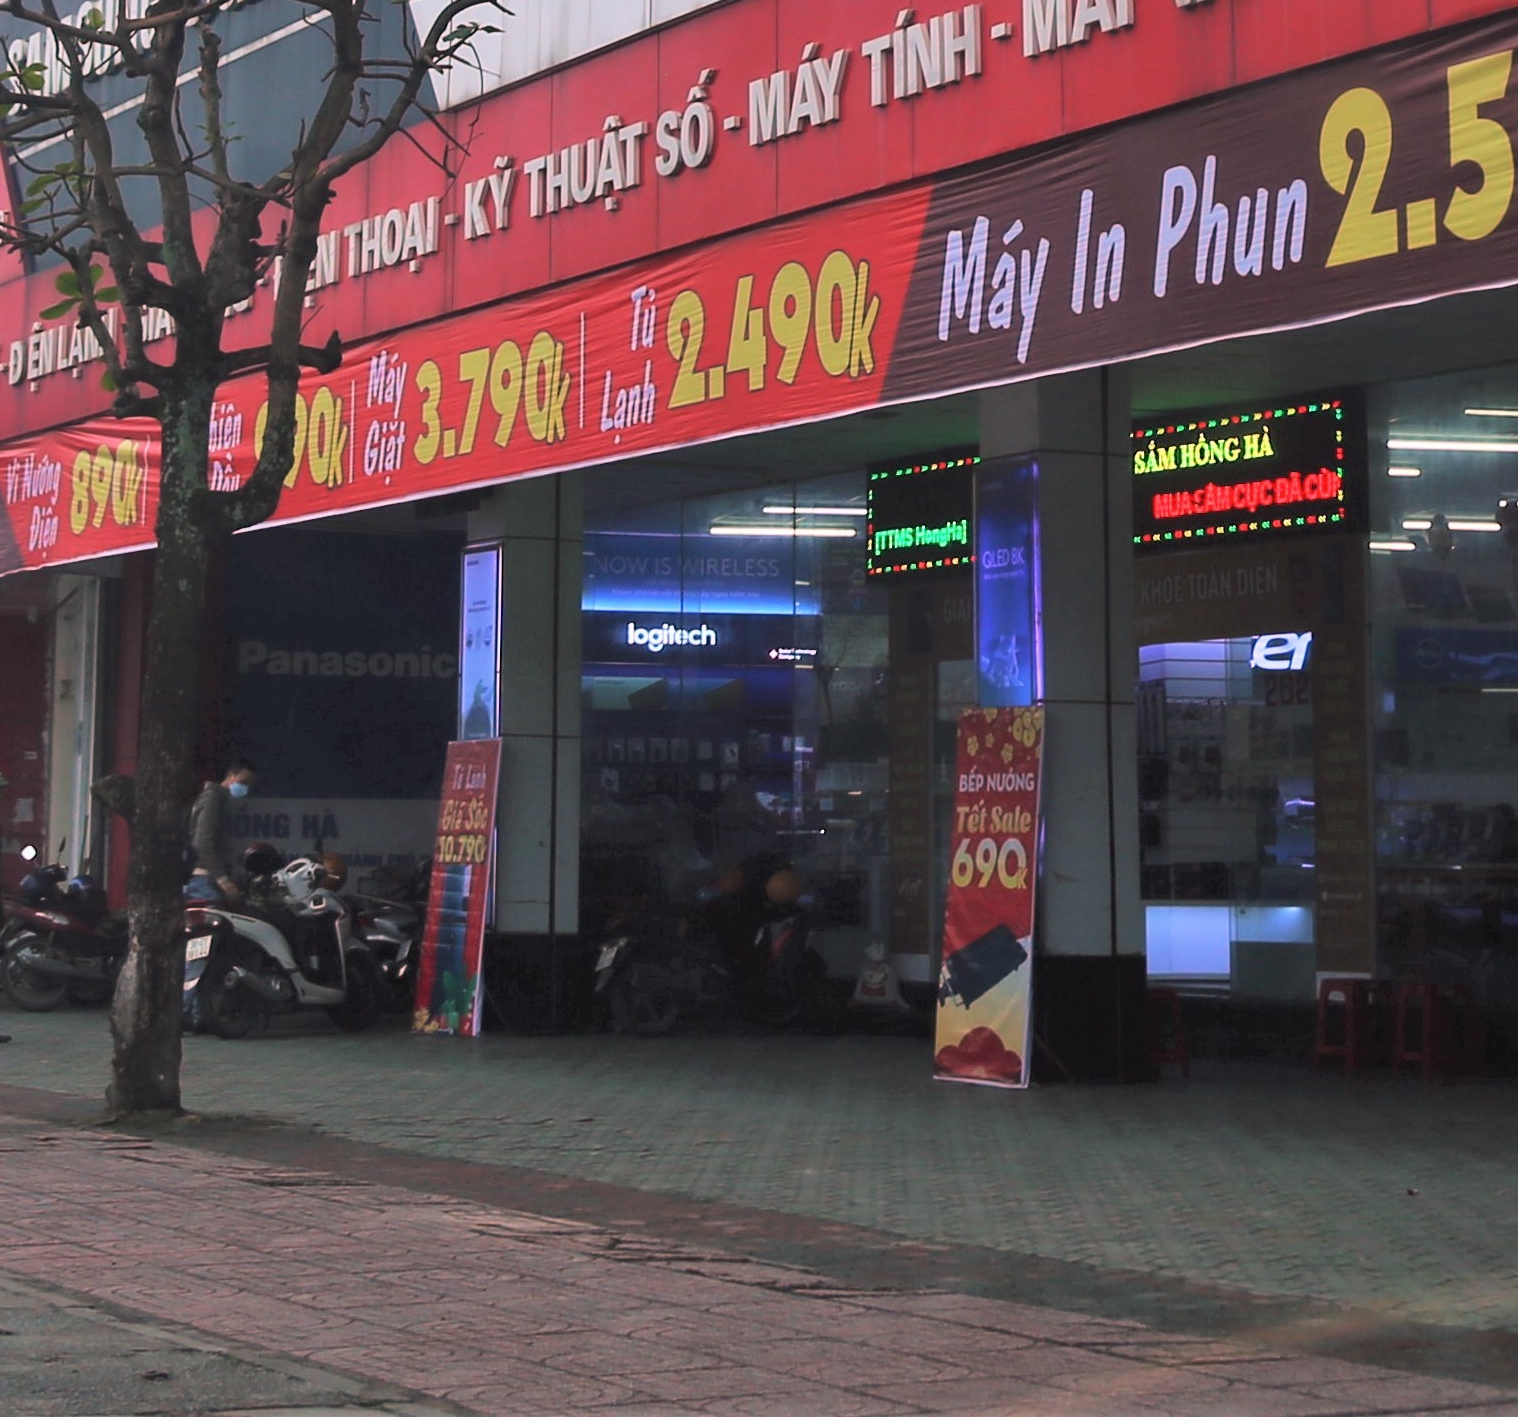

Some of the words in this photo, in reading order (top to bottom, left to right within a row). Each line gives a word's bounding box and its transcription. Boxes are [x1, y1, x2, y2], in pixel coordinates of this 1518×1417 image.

[343, 193, 441, 274] THOẠI
[463, 157, 518, 242] KỸ
[523, 114, 648, 213] THUẬT
[654, 67, 717, 181] SỐ
[748, 40, 848, 147] MÁY
[861, 3, 984, 108] TÍNH
[938, 215, 1051, 365] Máy
[1070, 188, 1125, 315] In
[1153, 154, 1308, 299] Phun
[629, 285, 658, 353] Tủ
[668, 249, 881, 410] 2.490k
[366, 351, 408, 421] Máy
[414, 329, 572, 465] 3.790k
[600, 360, 657, 447] Lạnh
[362, 422, 408, 486] Giặt
[1179, 432, 1242, 469] HỒNG
[1243, 425, 1275, 460] HÀ
[70, 439, 144, 535] 890k
[28, 506, 59, 559] Điện
[593, 555, 648, 575] NOW
[654, 555, 673, 575] IS
[680, 557, 780, 578] WIRELESS
[238, 639, 457, 679] Panasonic
[626, 621, 717, 653] logitech
[958, 764, 984, 793] BẾP
[987, 767, 1035, 792] NƯỚNG
[231, 804, 291, 839] ỒNG
[301, 807, 339, 839] HÀ
[956, 799, 988, 835] Tết
[990, 805, 1032, 834] Sale
